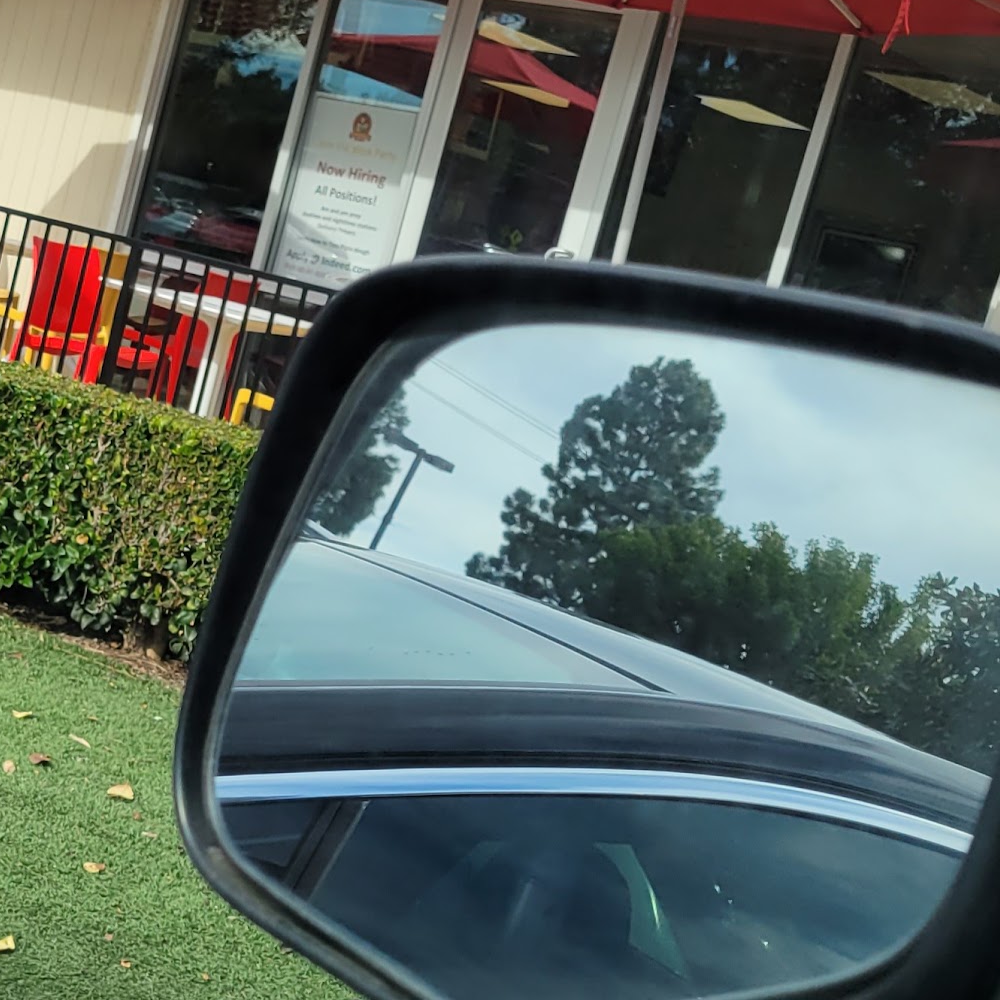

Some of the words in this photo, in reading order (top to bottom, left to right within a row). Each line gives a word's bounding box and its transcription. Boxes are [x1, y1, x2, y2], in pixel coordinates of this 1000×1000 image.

[316, 160, 346, 178] Now
[347, 166, 387, 190] Hiring
[314, 184, 329, 197] All
[328, 187, 379, 207] Positions!
